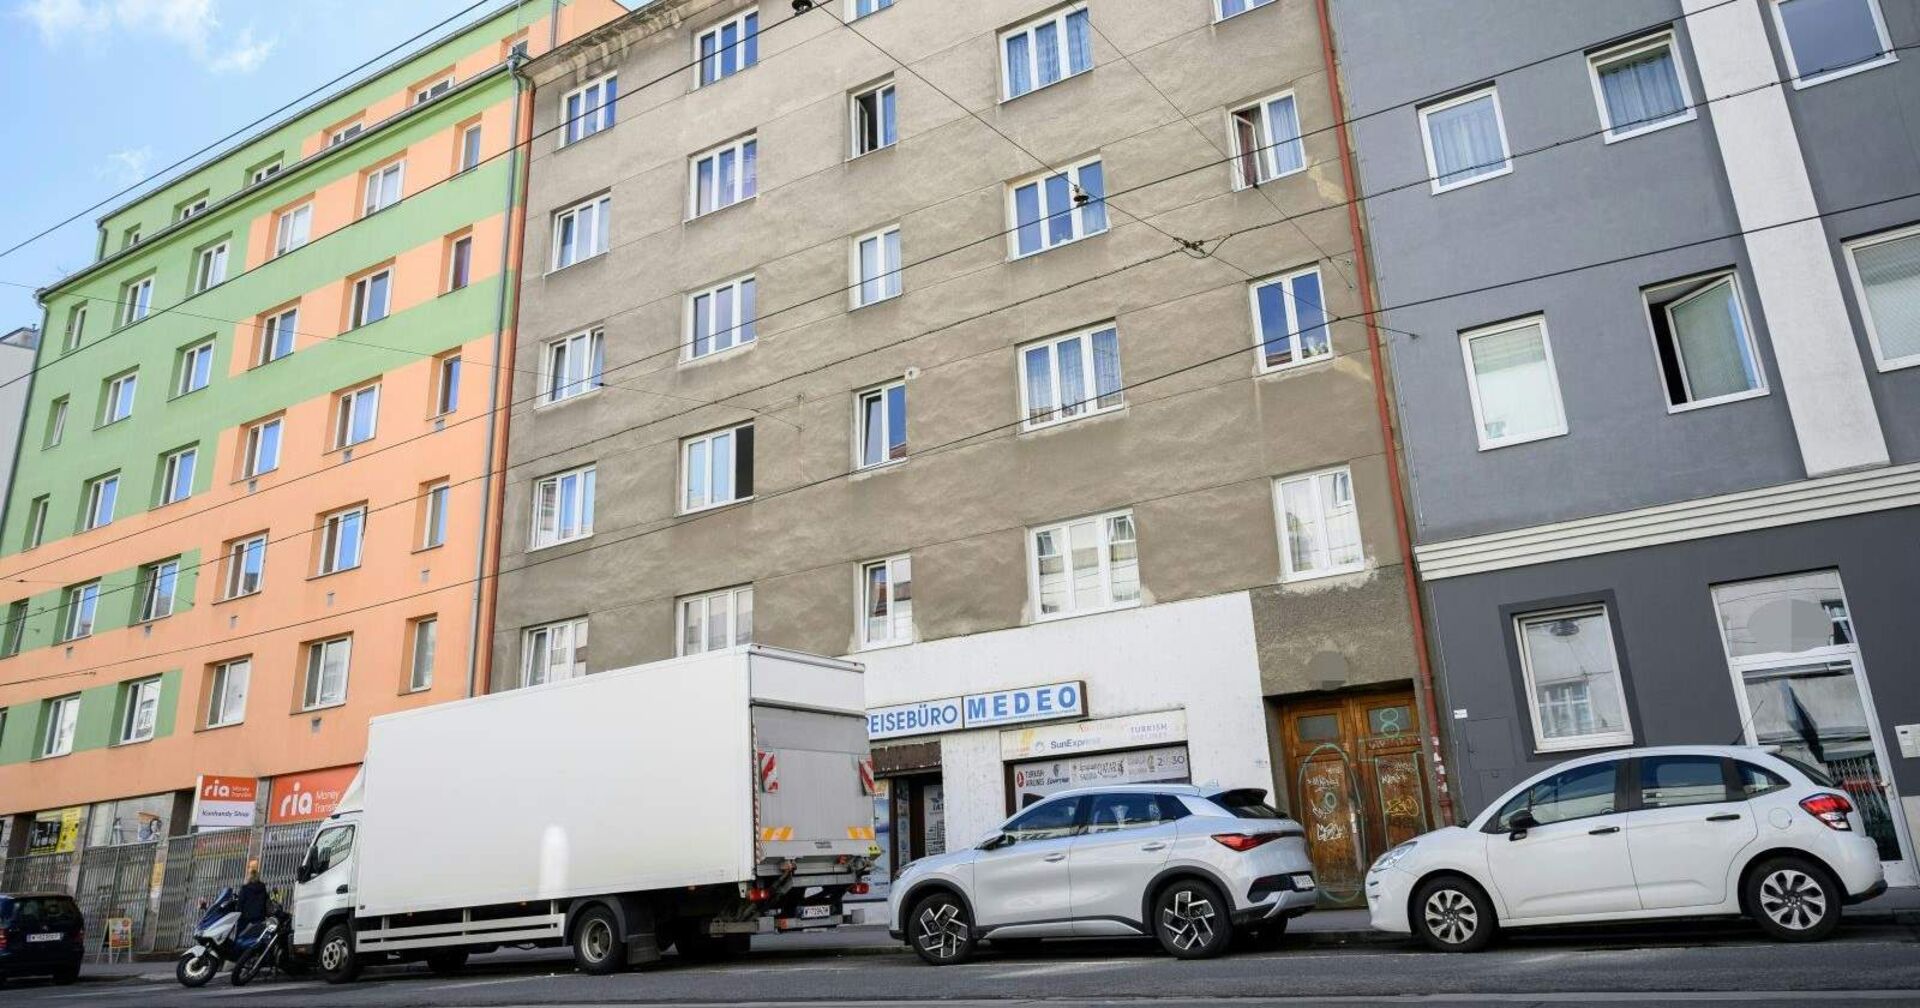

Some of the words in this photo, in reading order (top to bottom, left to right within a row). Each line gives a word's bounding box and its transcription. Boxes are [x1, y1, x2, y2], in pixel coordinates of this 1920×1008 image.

[967, 686, 1076, 720] MEDEO
[1131, 723, 1168, 734] TURKISH
[204, 779, 230, 797] ria
[316, 789, 340, 802] Money
[280, 781, 313, 817] ria
